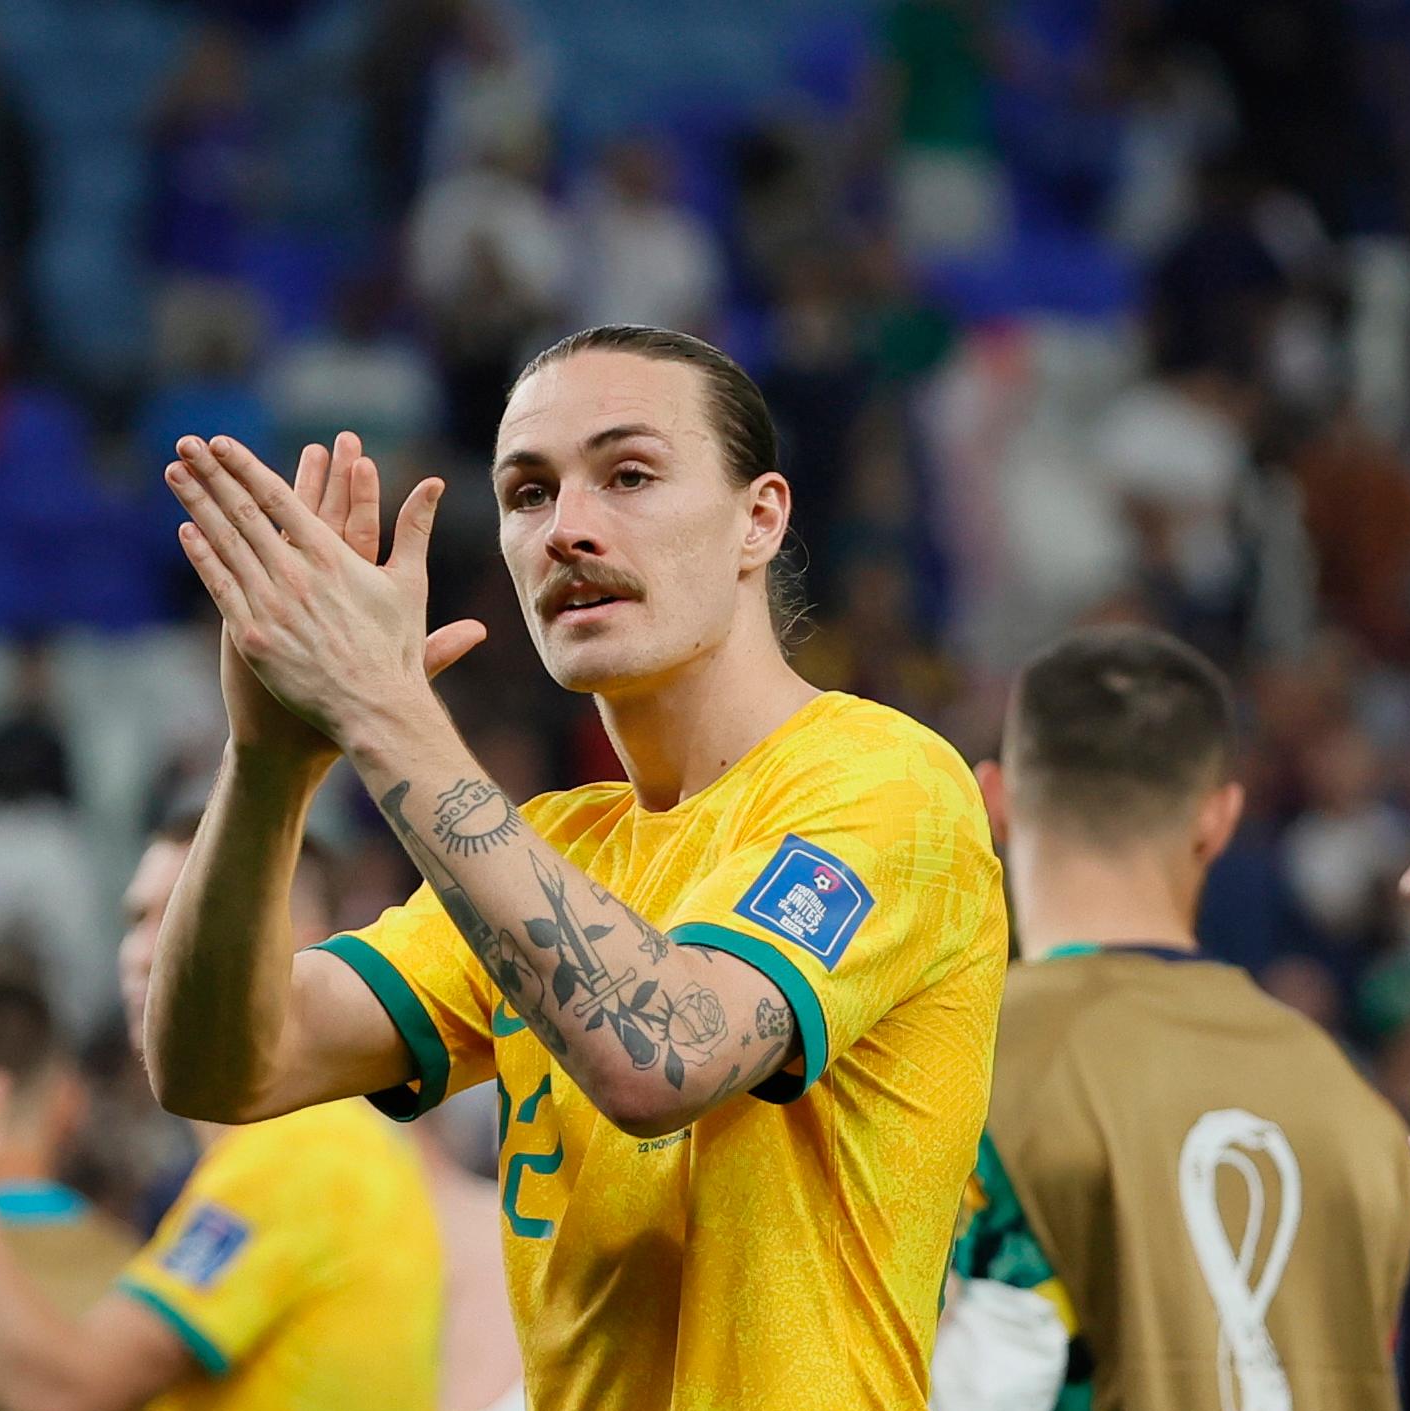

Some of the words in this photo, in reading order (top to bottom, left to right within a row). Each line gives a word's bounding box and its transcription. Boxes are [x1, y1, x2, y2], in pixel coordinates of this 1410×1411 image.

[432, 799, 469, 836] SOON
[786, 888, 823, 927] UNITES
[791, 882, 827, 918] FOOTBALL
[637, 1142, 649, 1153] 22
